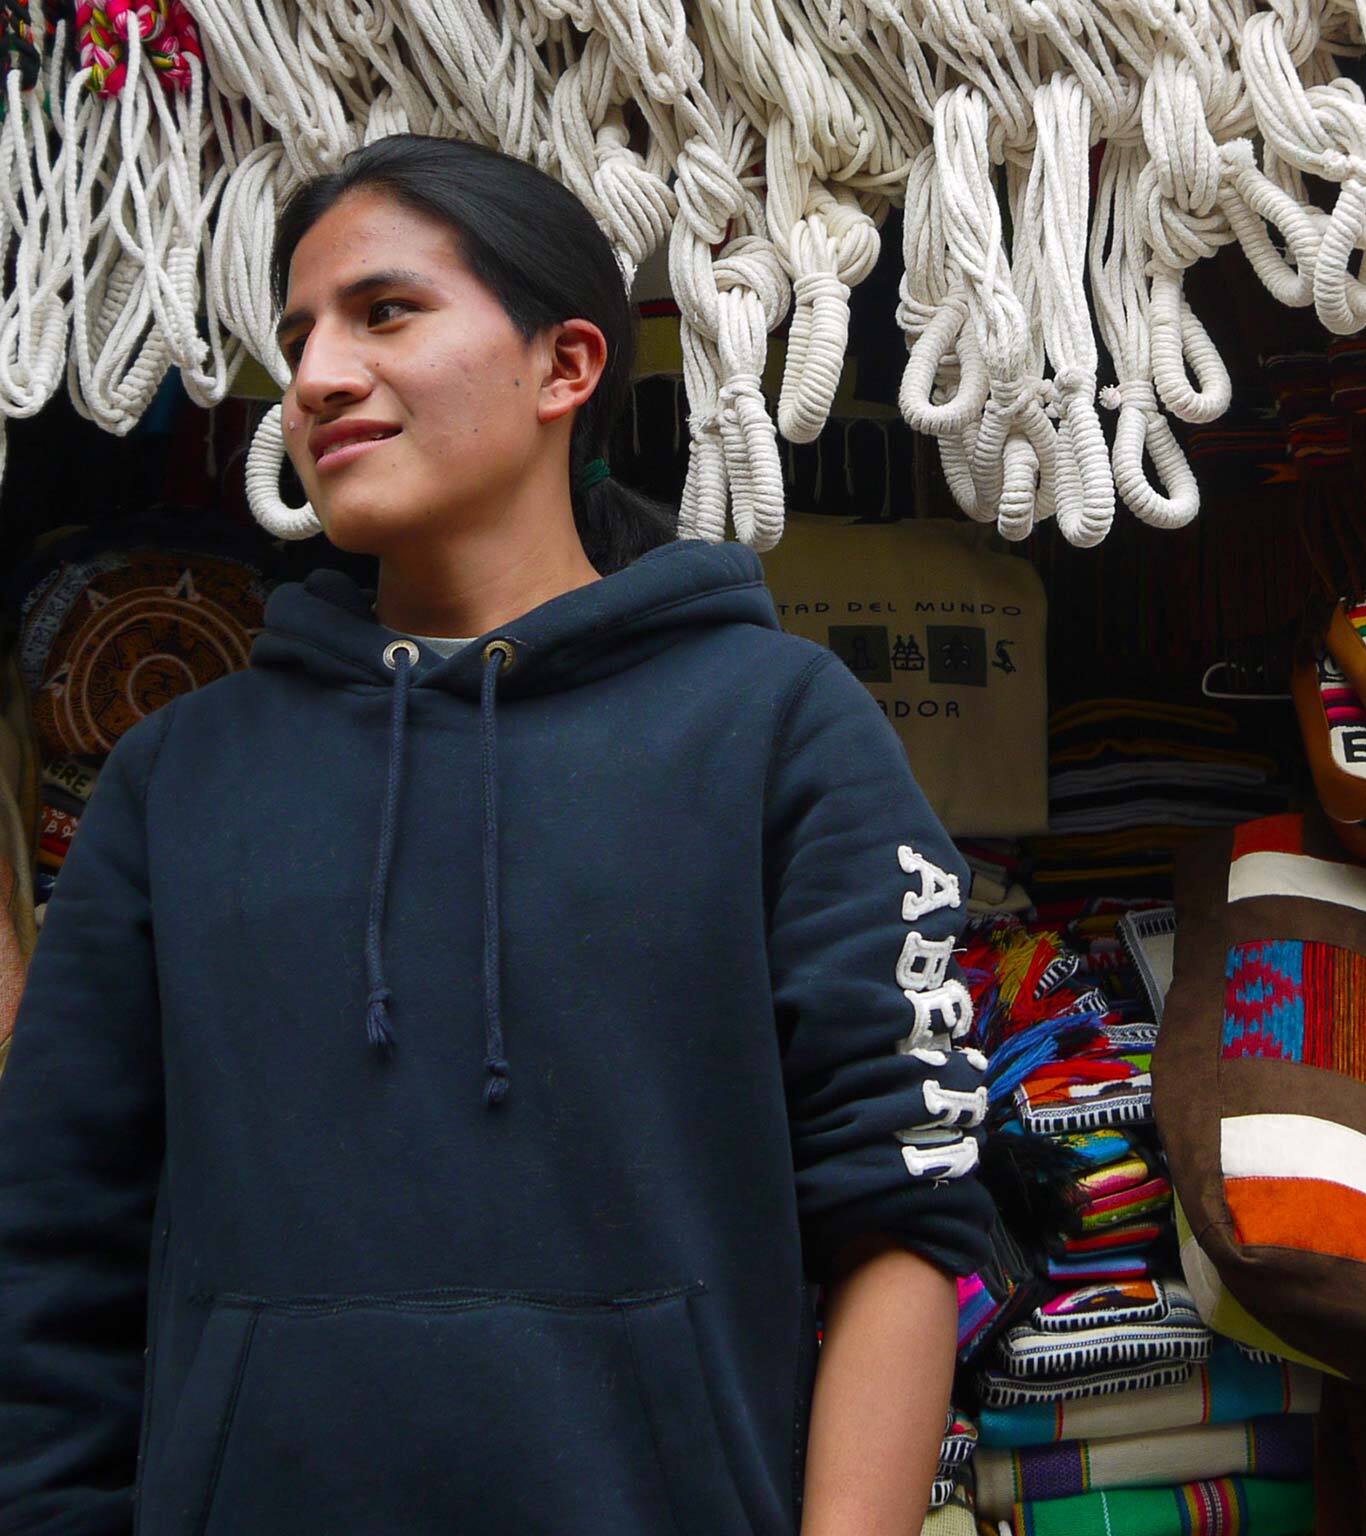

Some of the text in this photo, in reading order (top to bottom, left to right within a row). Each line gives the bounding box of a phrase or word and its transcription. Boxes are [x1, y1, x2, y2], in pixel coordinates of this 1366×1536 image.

[778, 602, 1021, 616] TAD DEL MUNDO
[877, 700, 960, 718] ADOR
